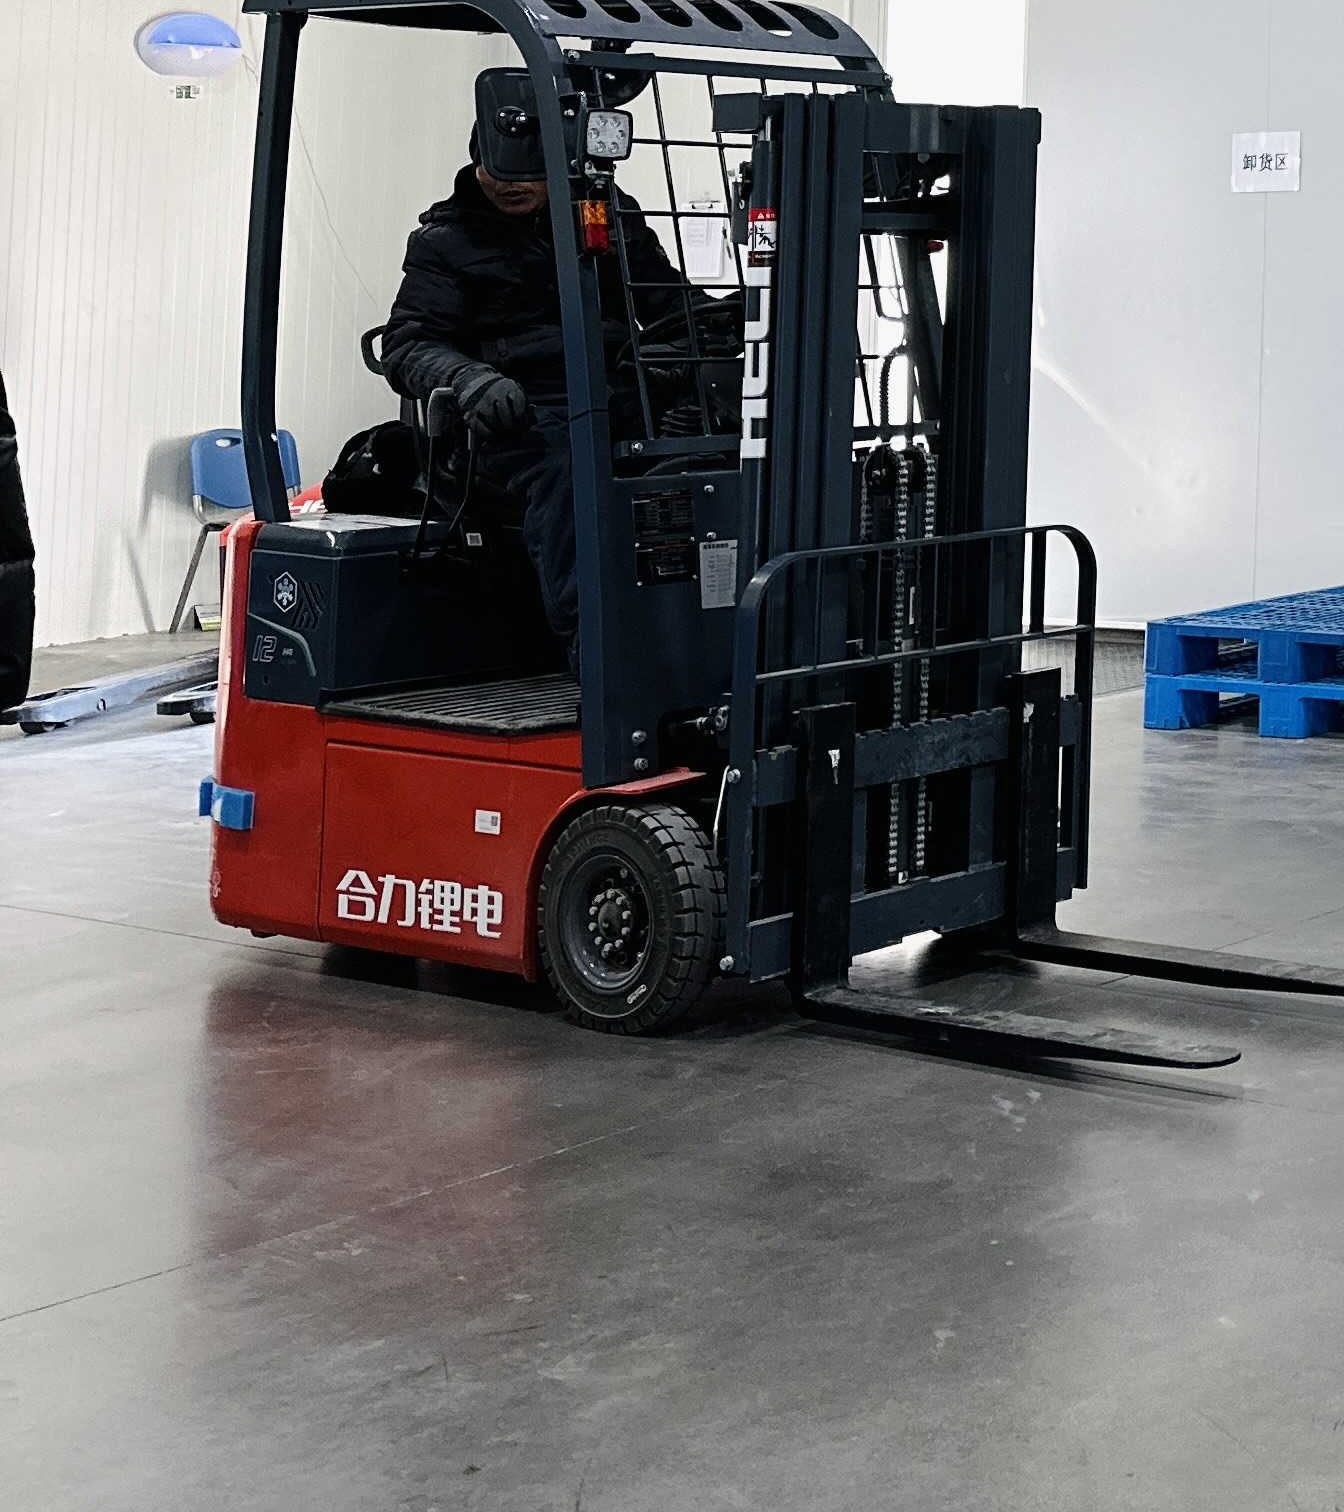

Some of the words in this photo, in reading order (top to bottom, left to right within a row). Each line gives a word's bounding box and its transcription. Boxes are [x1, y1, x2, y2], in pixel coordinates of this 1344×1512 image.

[1242, 152, 1288, 172] 卸货区
[740, 266, 772, 459] HELI
[252, 634, 278, 663] 12
[335, 869, 503, 939] 合力锂电
